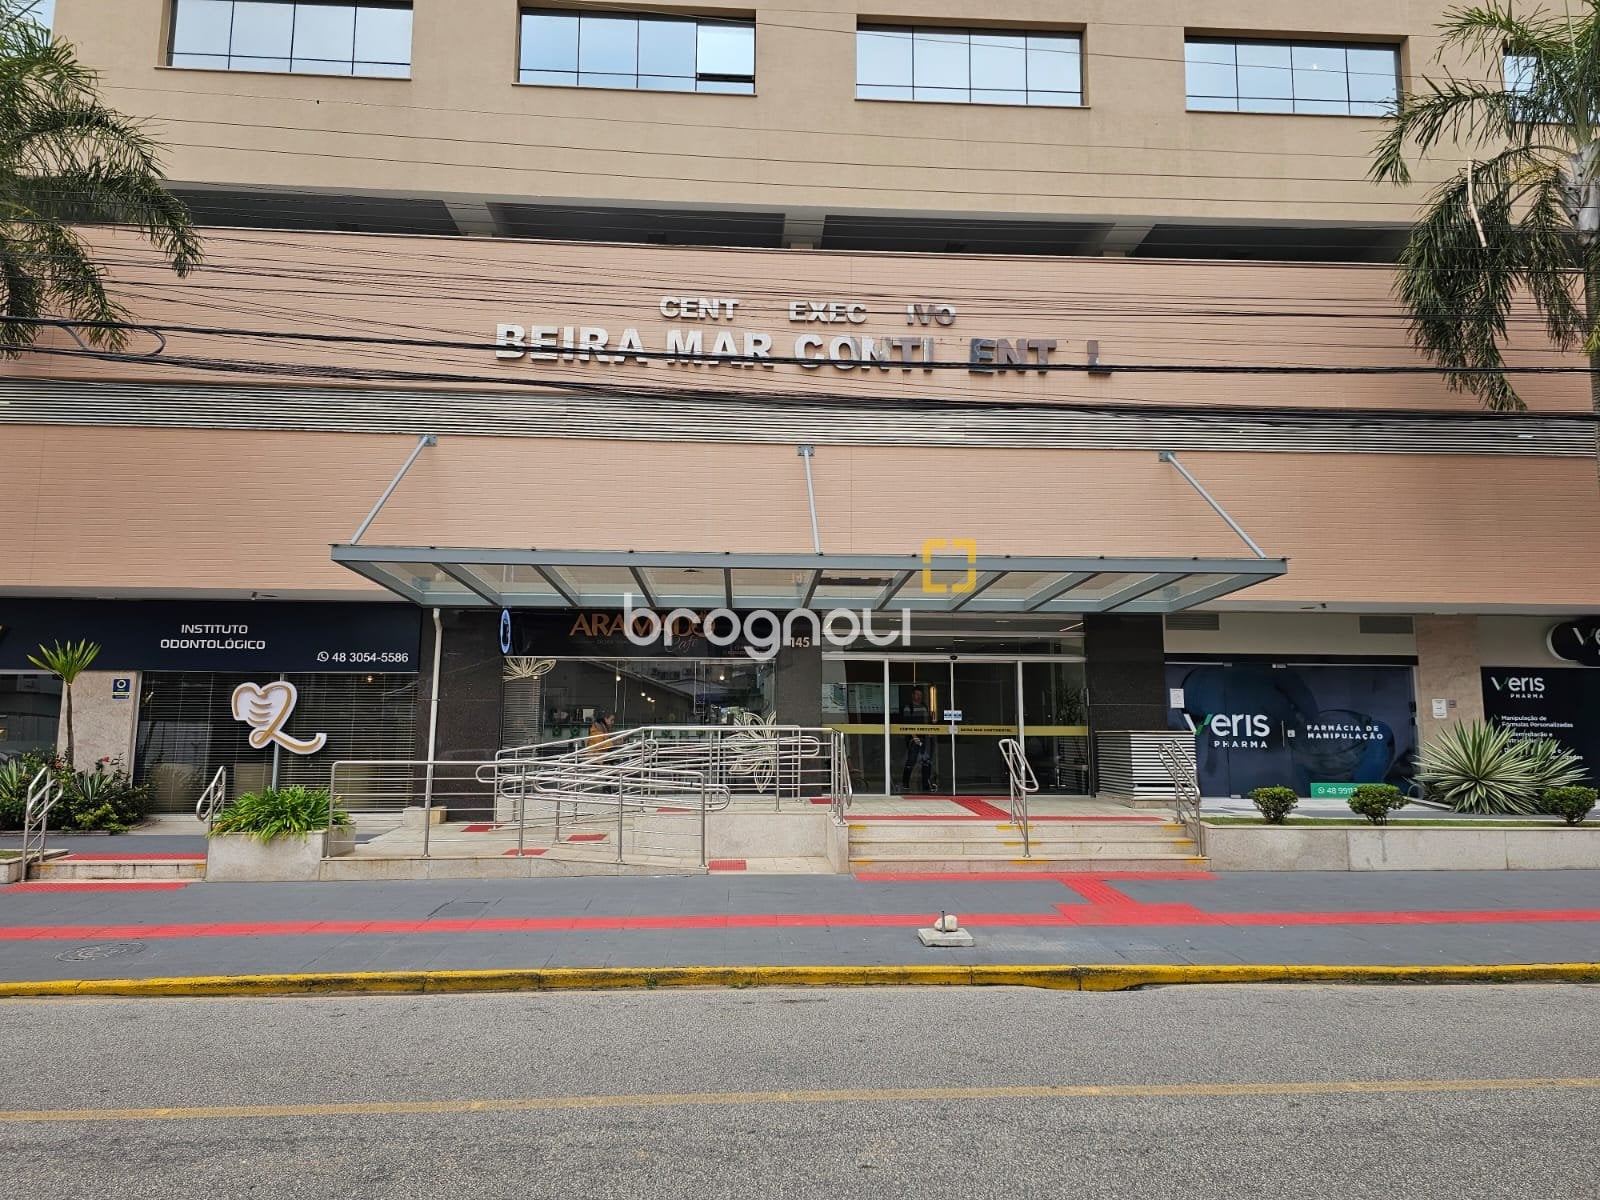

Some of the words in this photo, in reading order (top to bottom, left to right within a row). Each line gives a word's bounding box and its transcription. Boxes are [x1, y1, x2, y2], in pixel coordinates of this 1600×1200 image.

[495, 323, 648, 365] BEIRA
[666, 328, 775, 368] MAR
[180, 624, 248, 634] INSTITUTO
[160, 637, 266, 650] ODONTOLÓGICO
[791, 637, 810, 648] 145
[331, 652, 346, 662] 48
[349, 652, 409, 663] 3054-5586
[1306, 723, 1361, 732] FARMÁCIA
[1307, 732, 1384, 741] MANIPULAÇÃO
[1213, 740, 1268, 749] PHARMA
